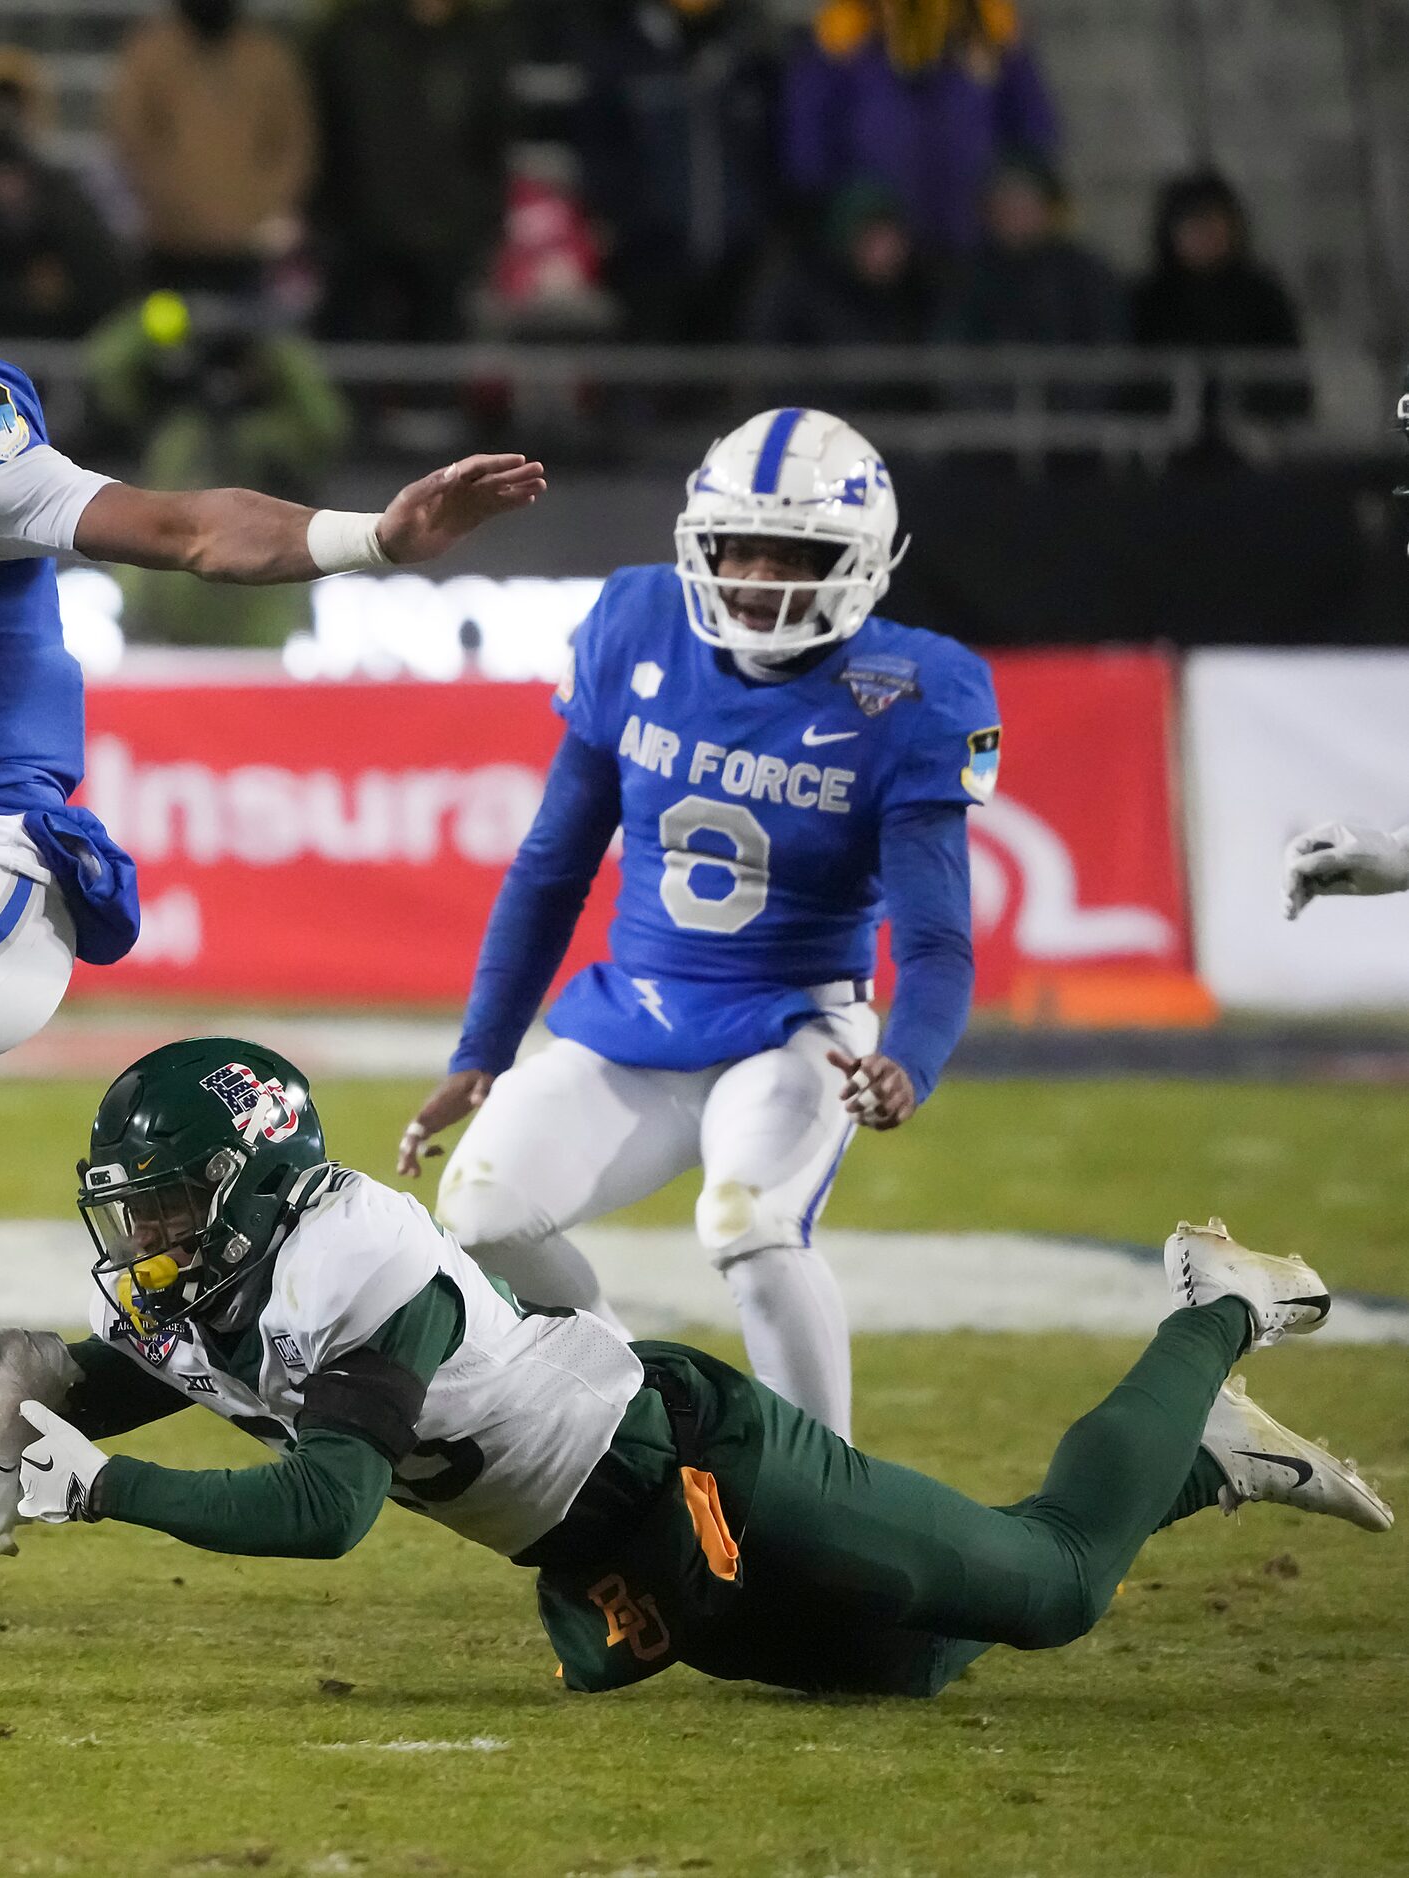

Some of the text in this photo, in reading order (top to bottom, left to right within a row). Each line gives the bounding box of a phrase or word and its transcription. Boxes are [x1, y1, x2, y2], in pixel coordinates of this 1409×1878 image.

[618, 715, 856, 813] AIR FORCE
[659, 794, 771, 935] 8
[199, 1062, 299, 1144] BU
[587, 1574, 670, 1661] BU
